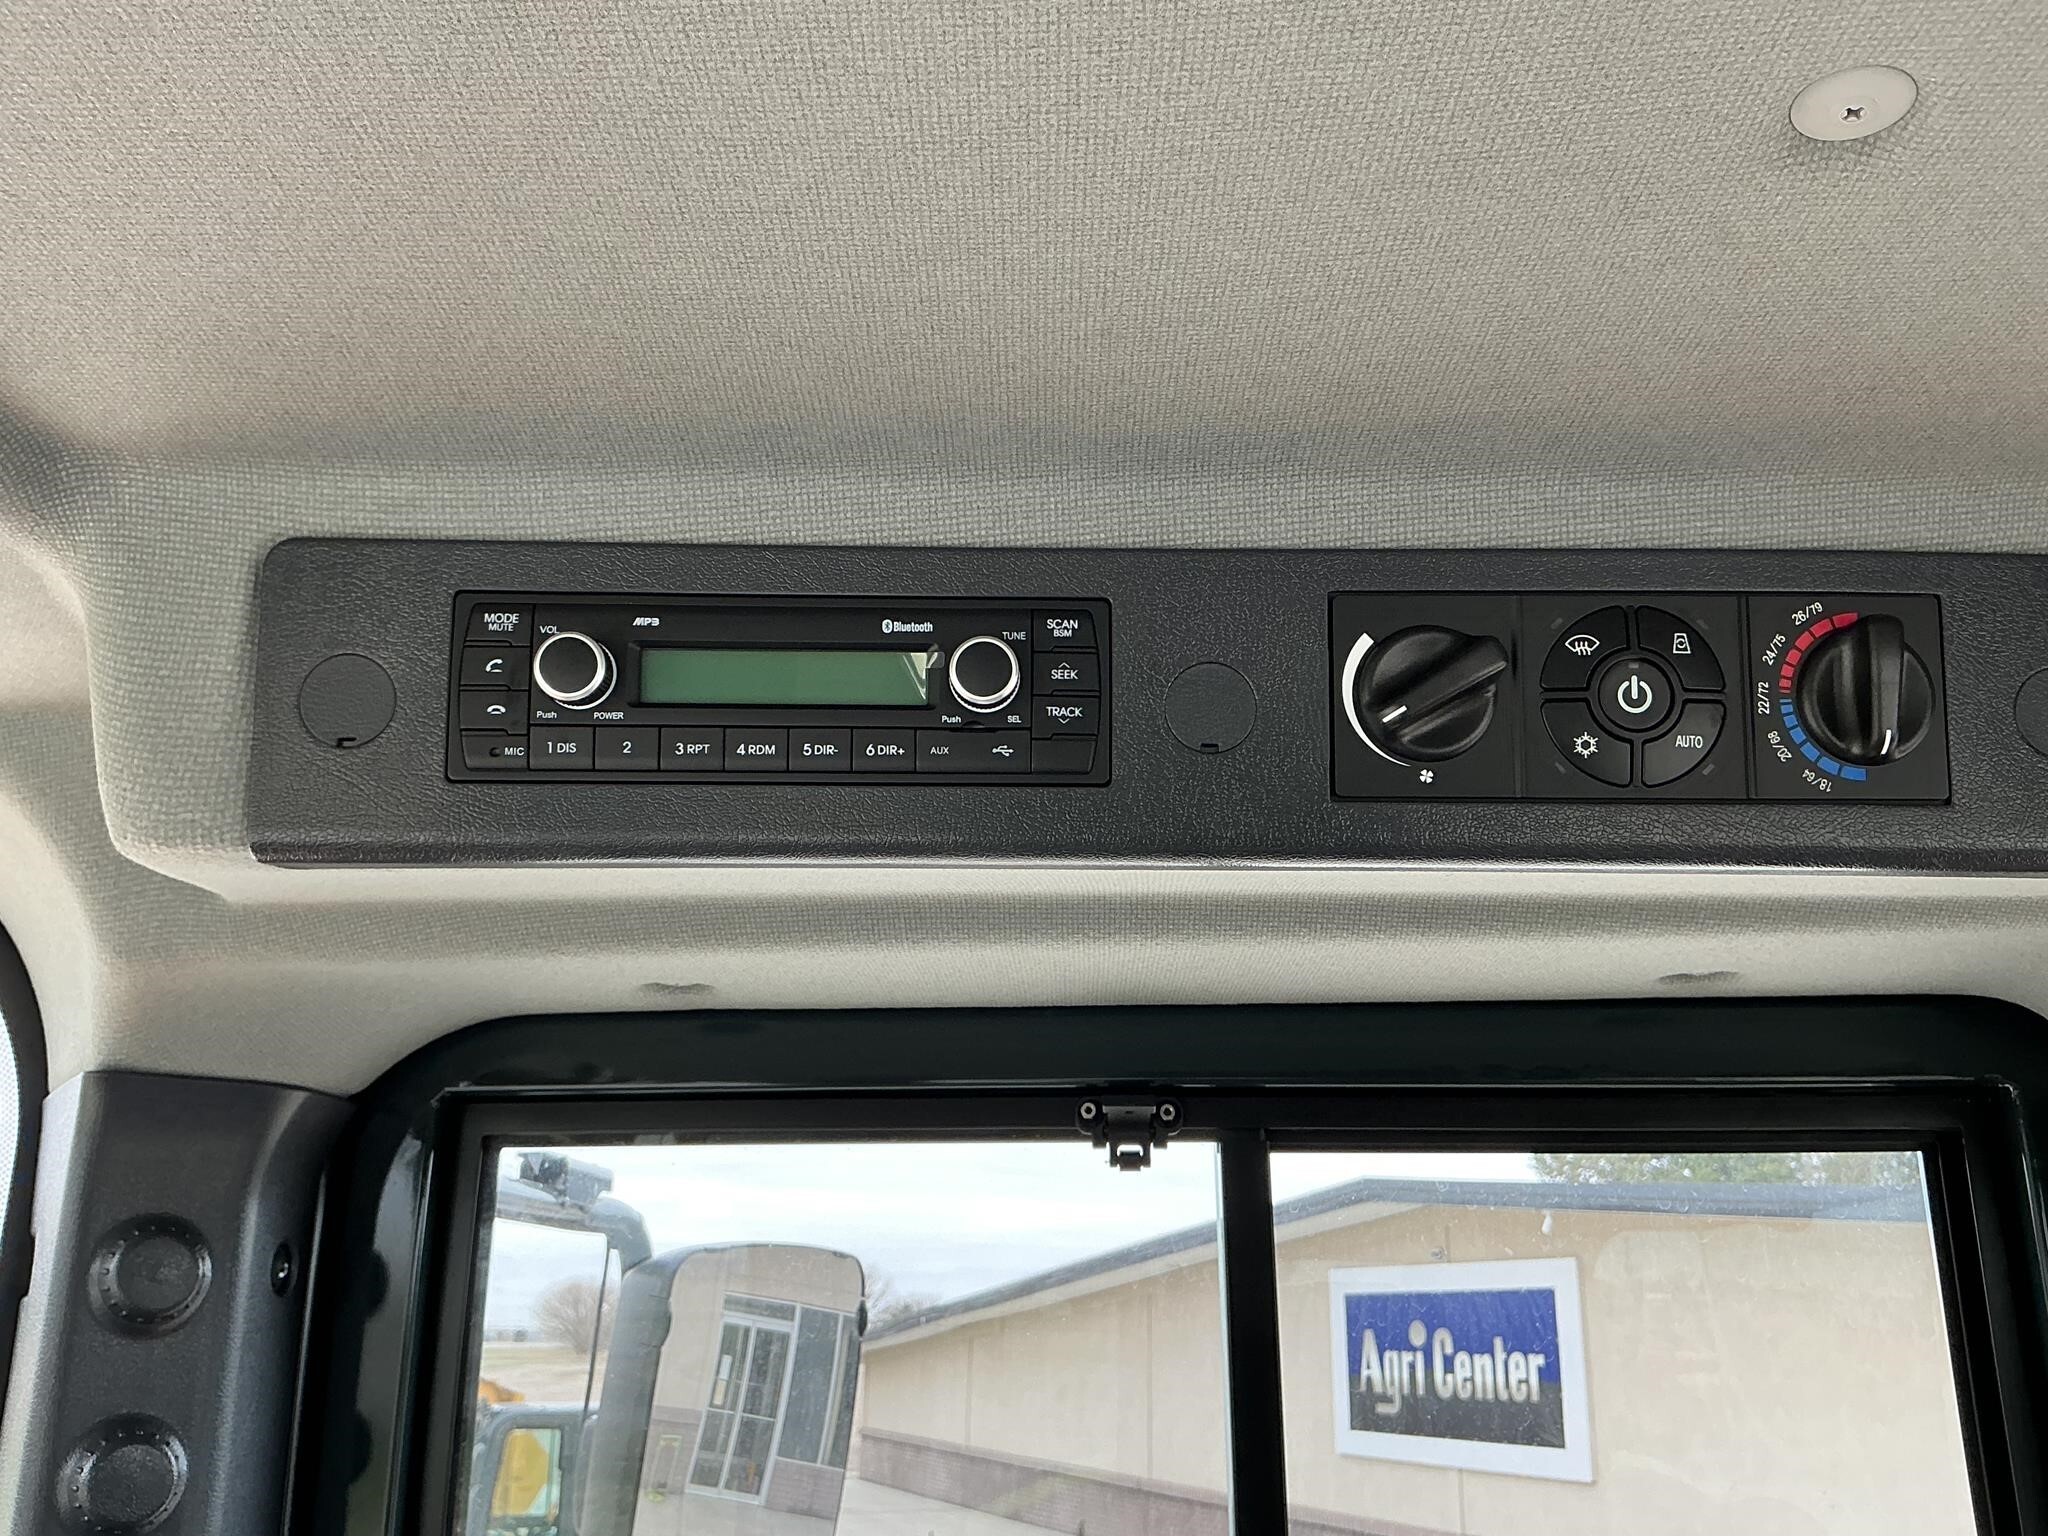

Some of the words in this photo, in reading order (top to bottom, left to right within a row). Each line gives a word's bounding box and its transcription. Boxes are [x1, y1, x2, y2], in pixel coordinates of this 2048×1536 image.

[484, 613, 520, 624] MODE
[1791, 601, 1824, 626] 26/79
[488, 623, 514, 632] MUTE
[633, 617, 660, 627] MP3
[893, 621, 933, 633] Bluetooth
[1046, 619, 1079, 630] SCAN
[540, 626, 560, 635] VOL
[1053, 629, 1072, 638] BSM
[1002, 632, 1026, 641] TUNE
[1762, 633, 1787, 666] 24/75
[1051, 669, 1079, 680] SEEK
[1757, 681, 1770, 715] 22/72
[536, 710, 557, 719] Push
[593, 711, 624, 720] POWER
[1046, 706, 1083, 718] TRACK
[941, 715, 962, 724] Push
[1007, 715, 1022, 724] SEL
[547, 742, 553, 753] 1
[557, 743, 577, 753] DIS
[1675, 735, 1703, 749] AUTO
[1767, 730, 1793, 762] 20/68
[504, 747, 525, 756] MIC
[622, 742, 632, 754] 2
[675, 743, 684, 755] 3
[687, 744, 710, 755] RPT
[736, 744, 746, 755] 4
[748, 744, 776, 755] RDM
[802, 744, 812, 756] 5
[866, 744, 875, 756] 6
[877, 745, 905, 756] DIR+
[930, 746, 949, 756] AUX
[1802, 768, 1832, 793] 18/64
[1359, 1320, 1428, 1415] Agri
[1432, 1327, 1546, 1404] Center
